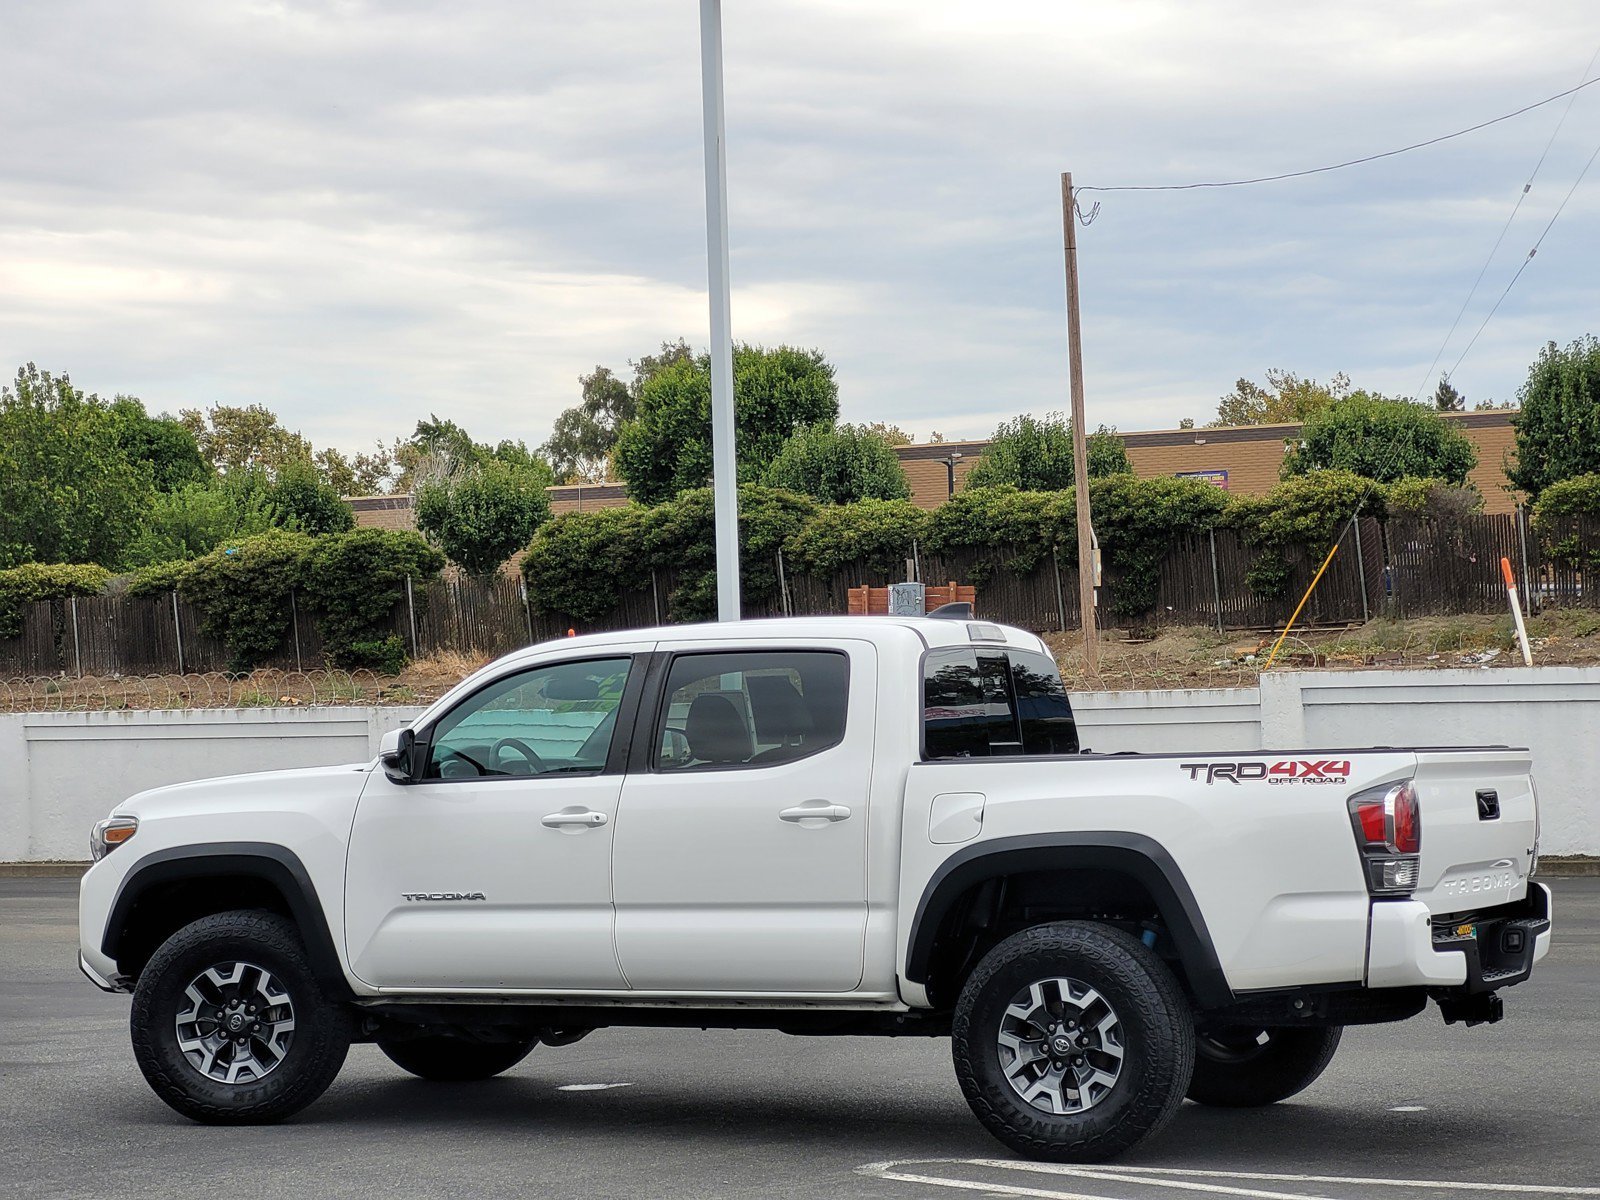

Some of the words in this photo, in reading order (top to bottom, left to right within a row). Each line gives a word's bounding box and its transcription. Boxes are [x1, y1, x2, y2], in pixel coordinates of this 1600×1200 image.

[1180, 762, 1268, 785] TRD
[1269, 760, 1351, 777] 4X4
[1268, 777, 1300, 786] OFF
[1302, 777, 1346, 785] ROAD
[1444, 872, 1512, 895] TACOMA
[401, 891, 486, 901] TACOMA
